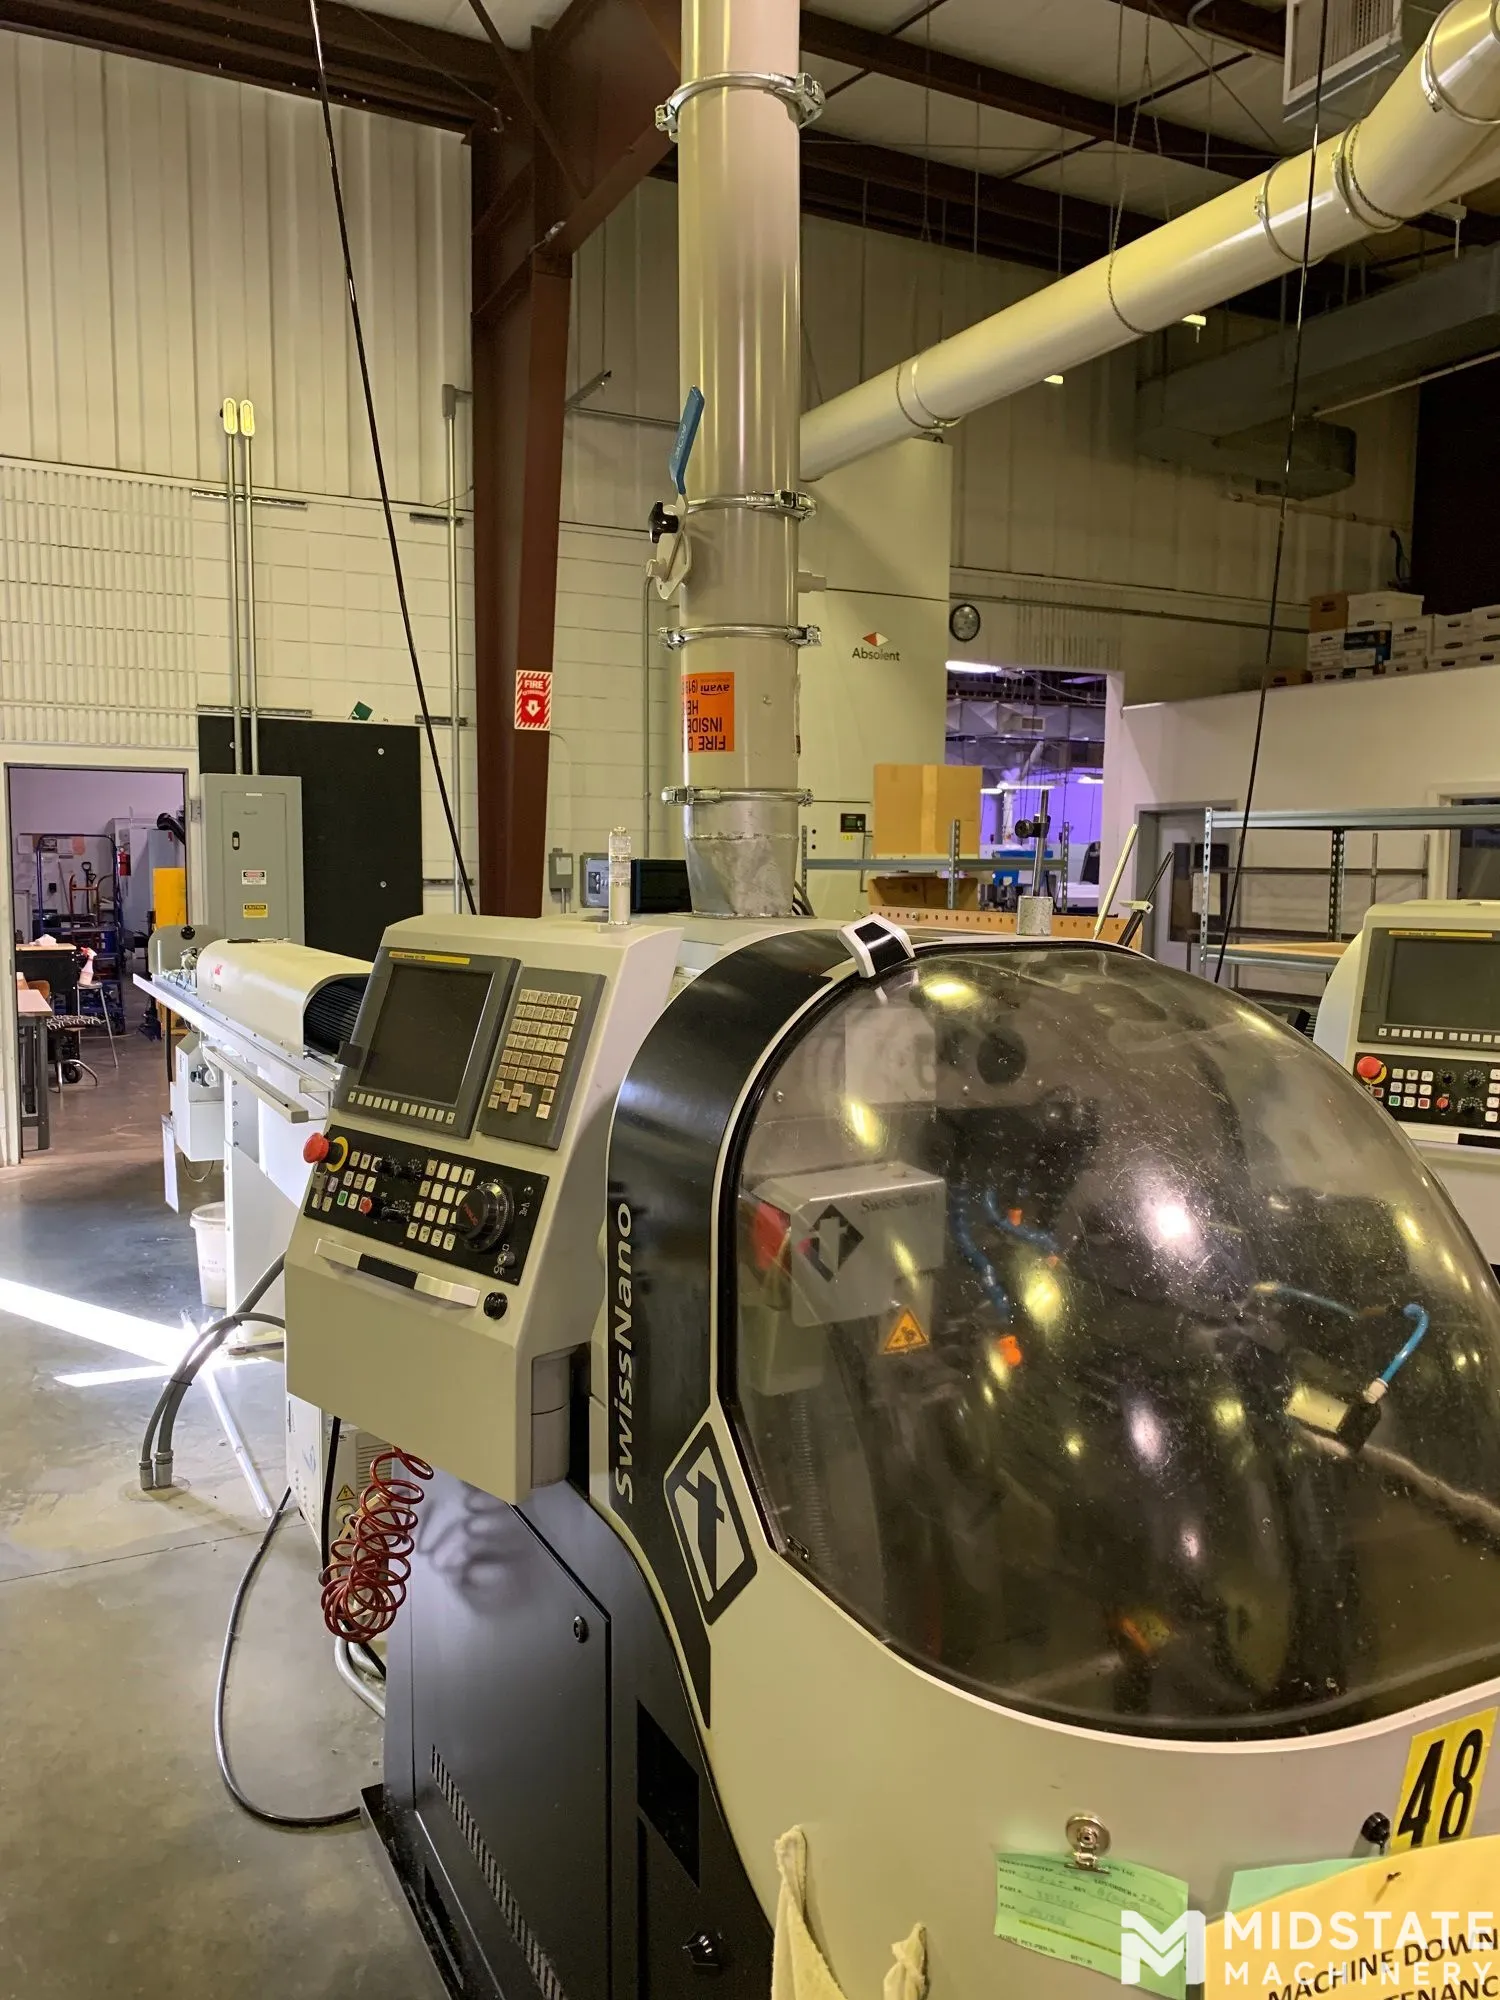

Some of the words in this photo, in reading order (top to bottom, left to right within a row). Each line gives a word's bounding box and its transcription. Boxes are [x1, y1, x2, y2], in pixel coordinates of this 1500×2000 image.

[852, 647, 901, 661] Absolent
[524, 680, 544, 689] FIRE
[700, 683, 730, 692] avani
[684, 699, 699, 715] HE
[698, 735, 726, 750] FIRE
[614, 1203, 633, 1504] SwissNano
[1398, 1728, 1483, 1848] 48
[1268, 1949, 1395, 2000] MACHINE
[1404, 1928, 1499, 1967] DOWN
[1384, 1975, 1499, 2000] NANC
